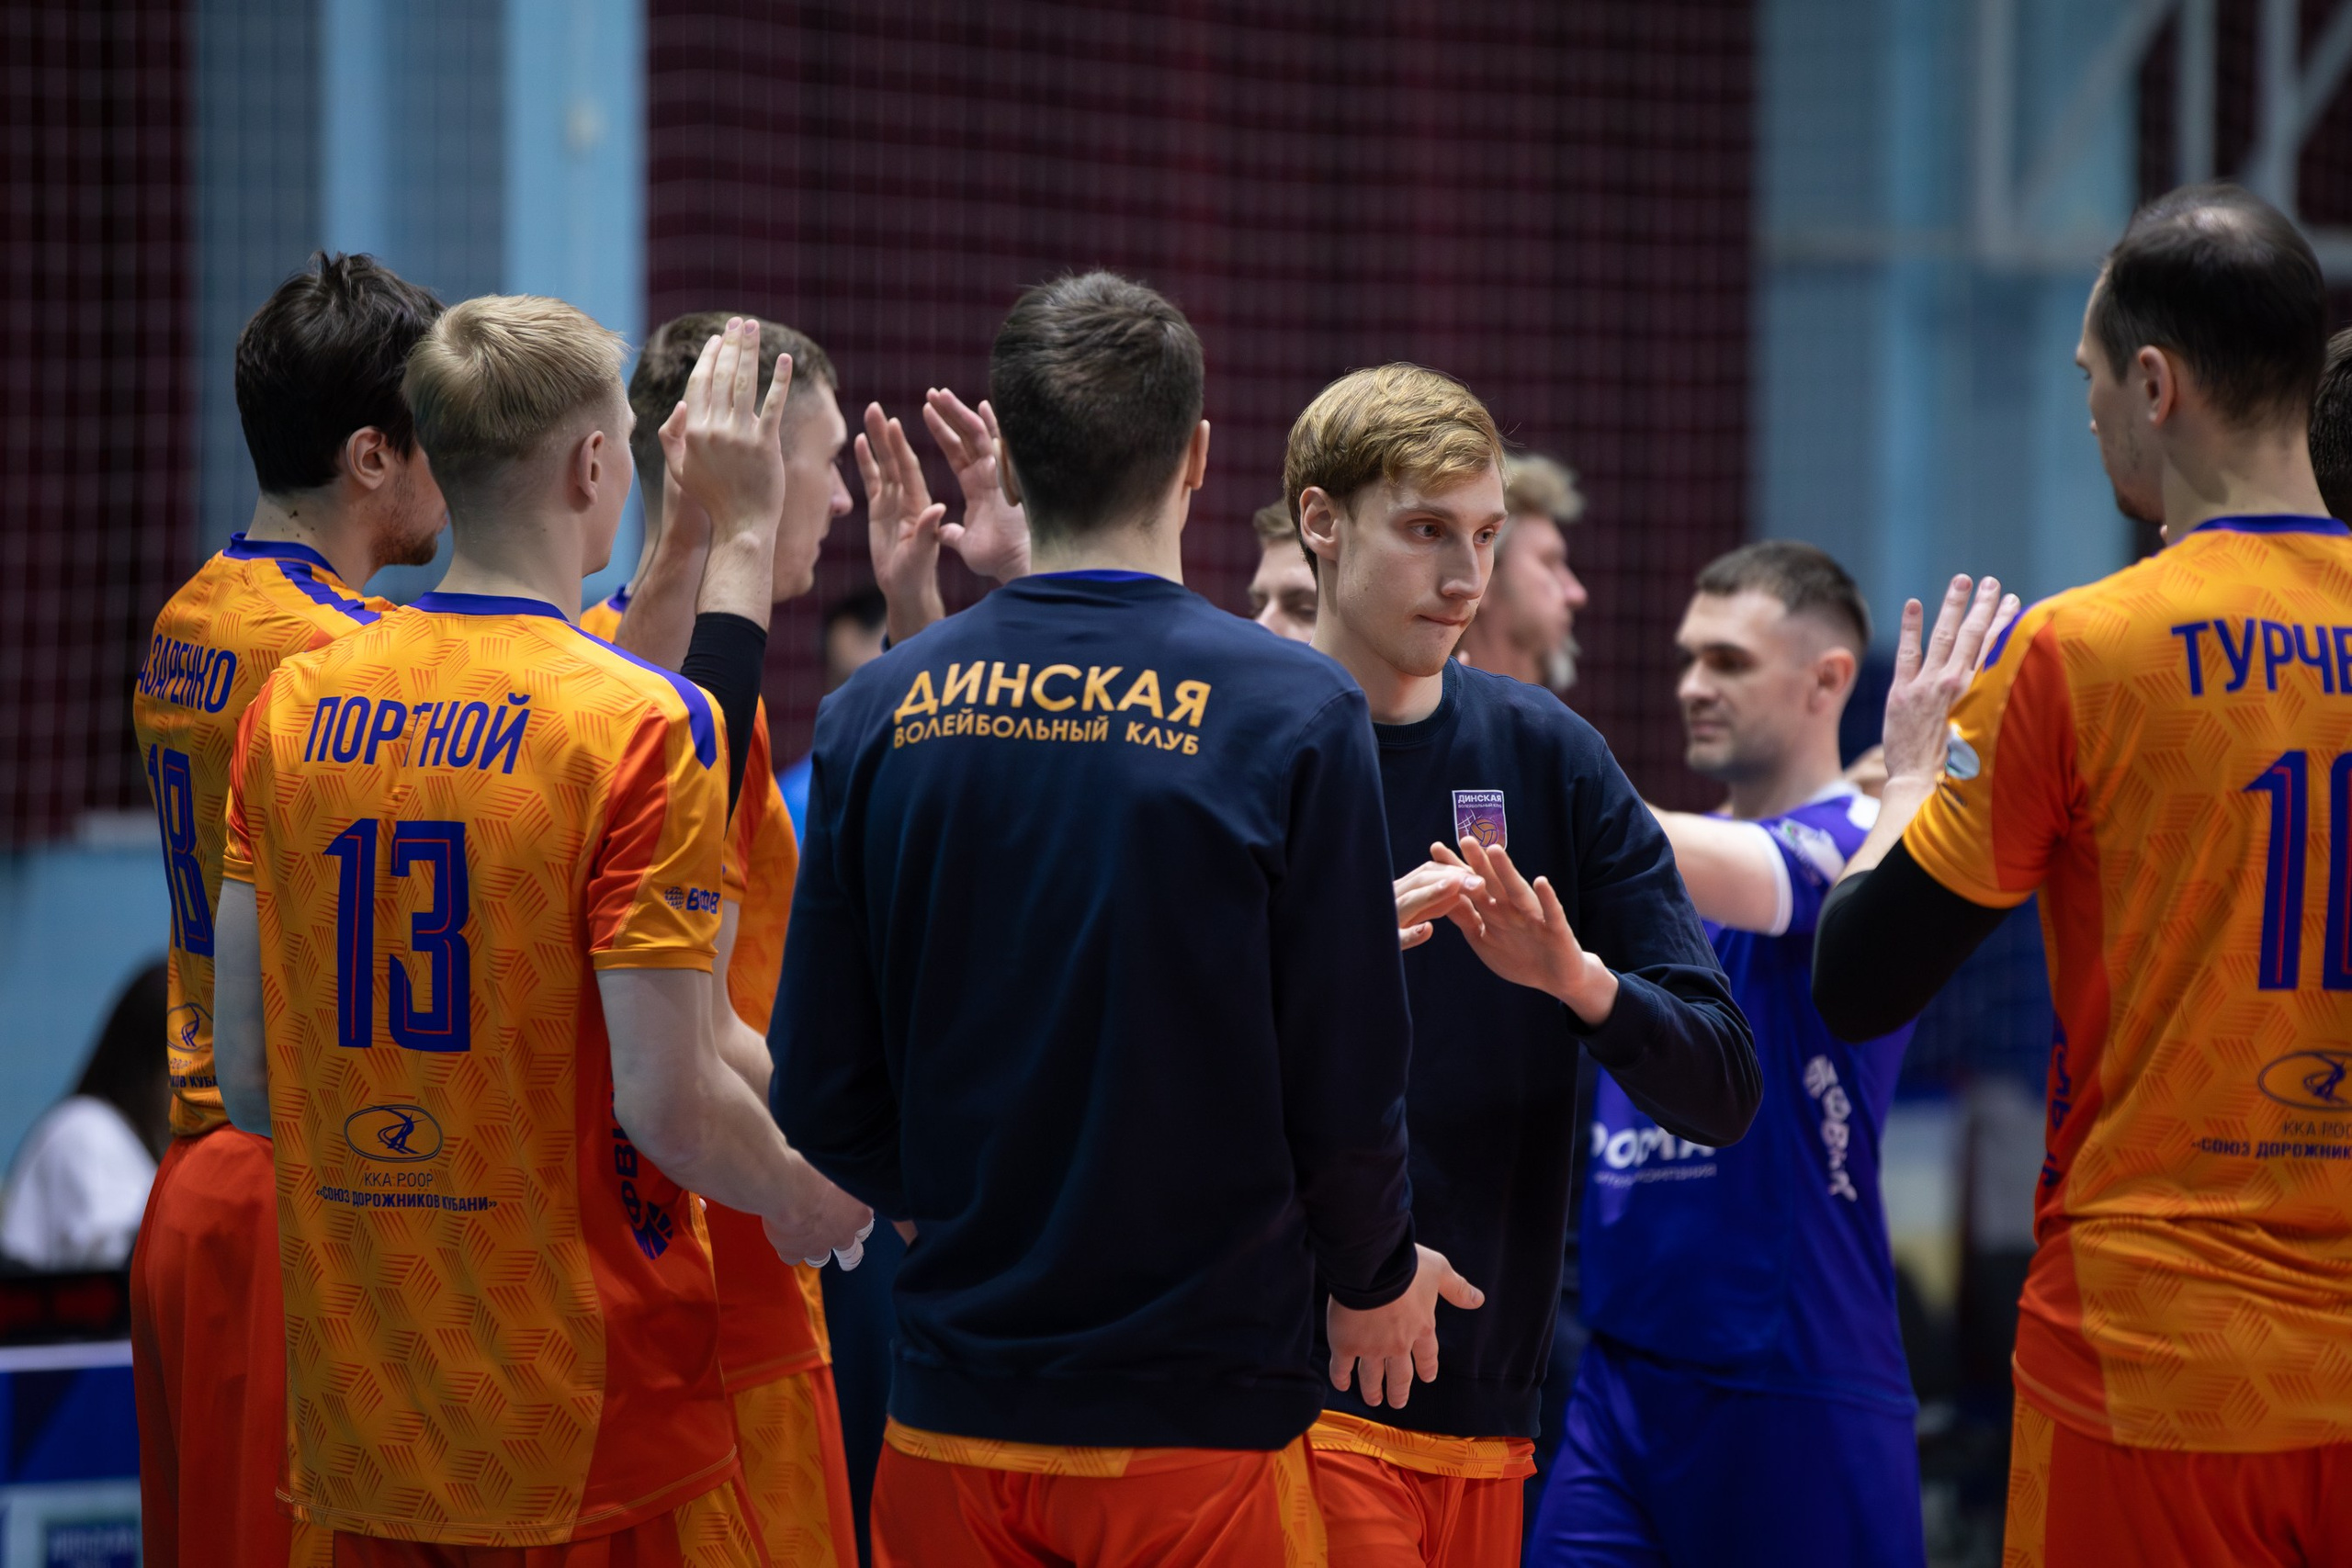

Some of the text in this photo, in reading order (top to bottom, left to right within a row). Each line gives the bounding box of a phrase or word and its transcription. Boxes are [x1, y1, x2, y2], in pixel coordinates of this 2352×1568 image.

[894, 660, 1212, 728] ДИНСКАЯ
[304, 693, 530, 774] ПОРТНОЙ
[894, 708, 1200, 755] ВОЛЕЙБОЛЬНЫЙ КЛУБ
[1458, 795, 1502, 804] ДИНСКАЯ
[148, 743, 214, 957] 18
[686, 887, 720, 914] ВФВ
[324, 818, 470, 1052] 13
[353, 1191, 440, 1208] ДОРОЖНИКОВ
[364, 1172, 433, 1188] ККА РООР
